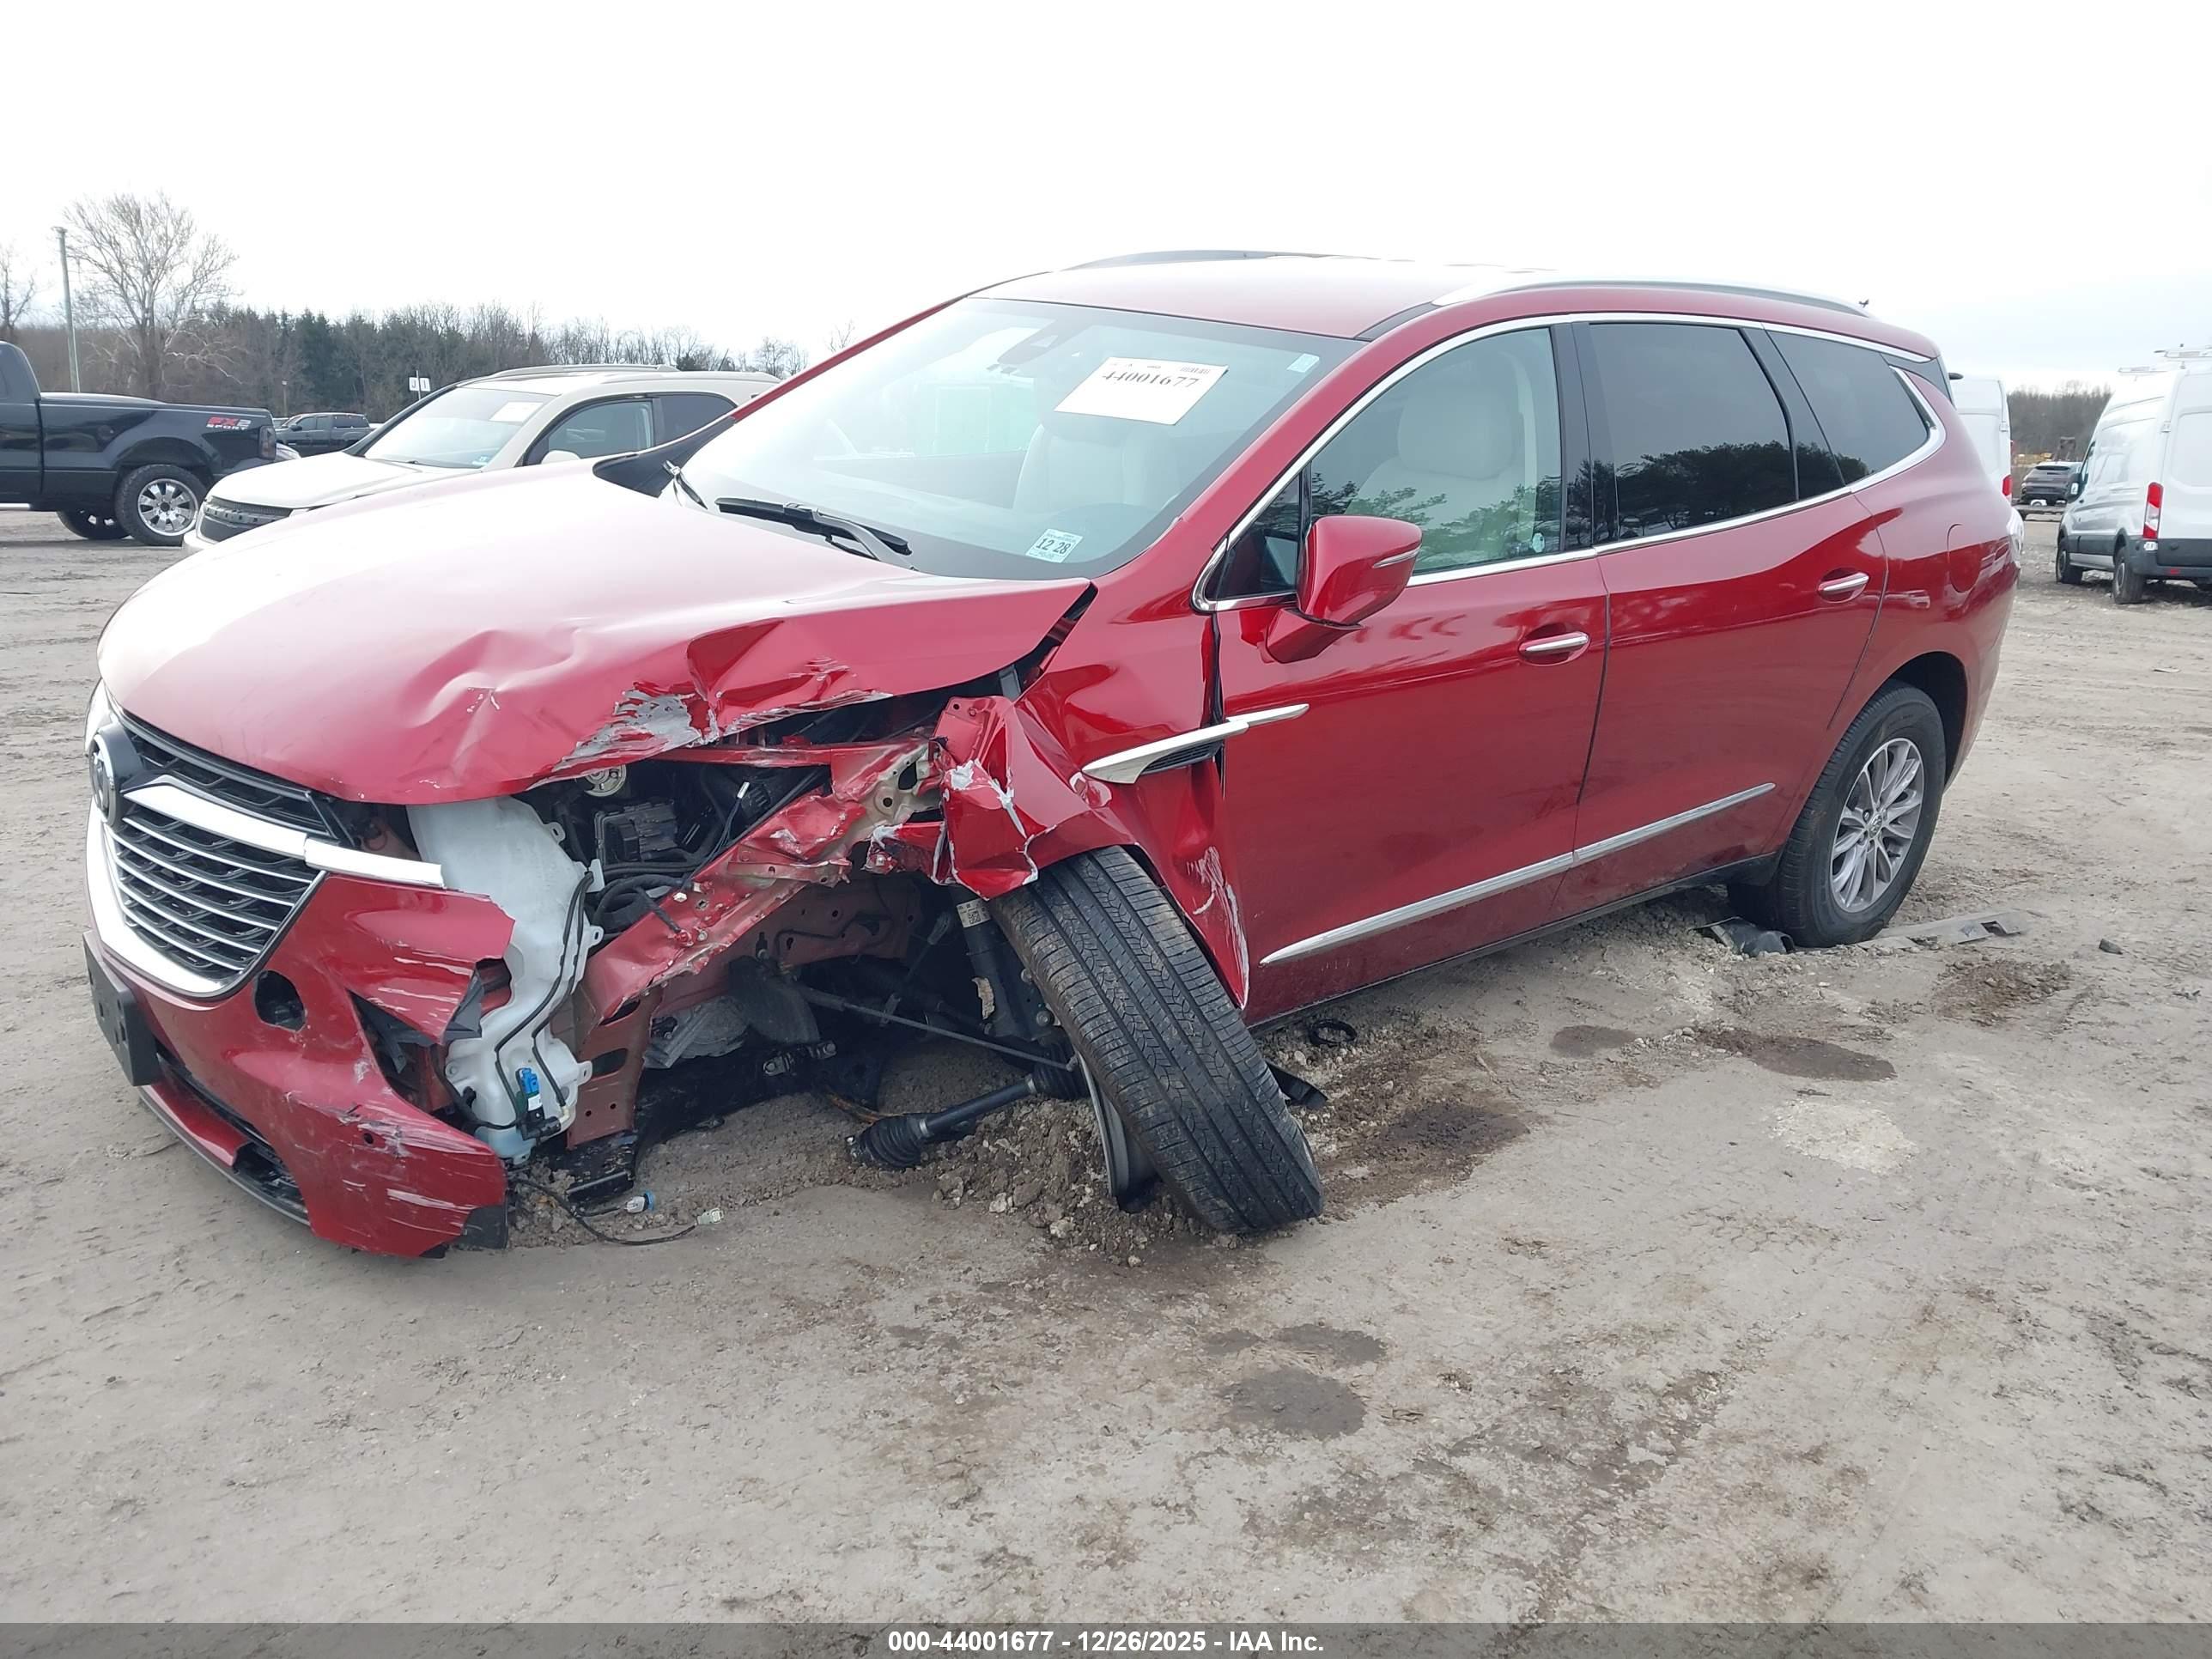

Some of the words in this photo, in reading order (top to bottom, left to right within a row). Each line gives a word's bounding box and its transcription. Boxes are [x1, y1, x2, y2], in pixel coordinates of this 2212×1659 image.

[1103, 371, 1200, 387] 44001677
[1036, 538, 1054, 550] 12
[1053, 542, 1072, 555] 28
